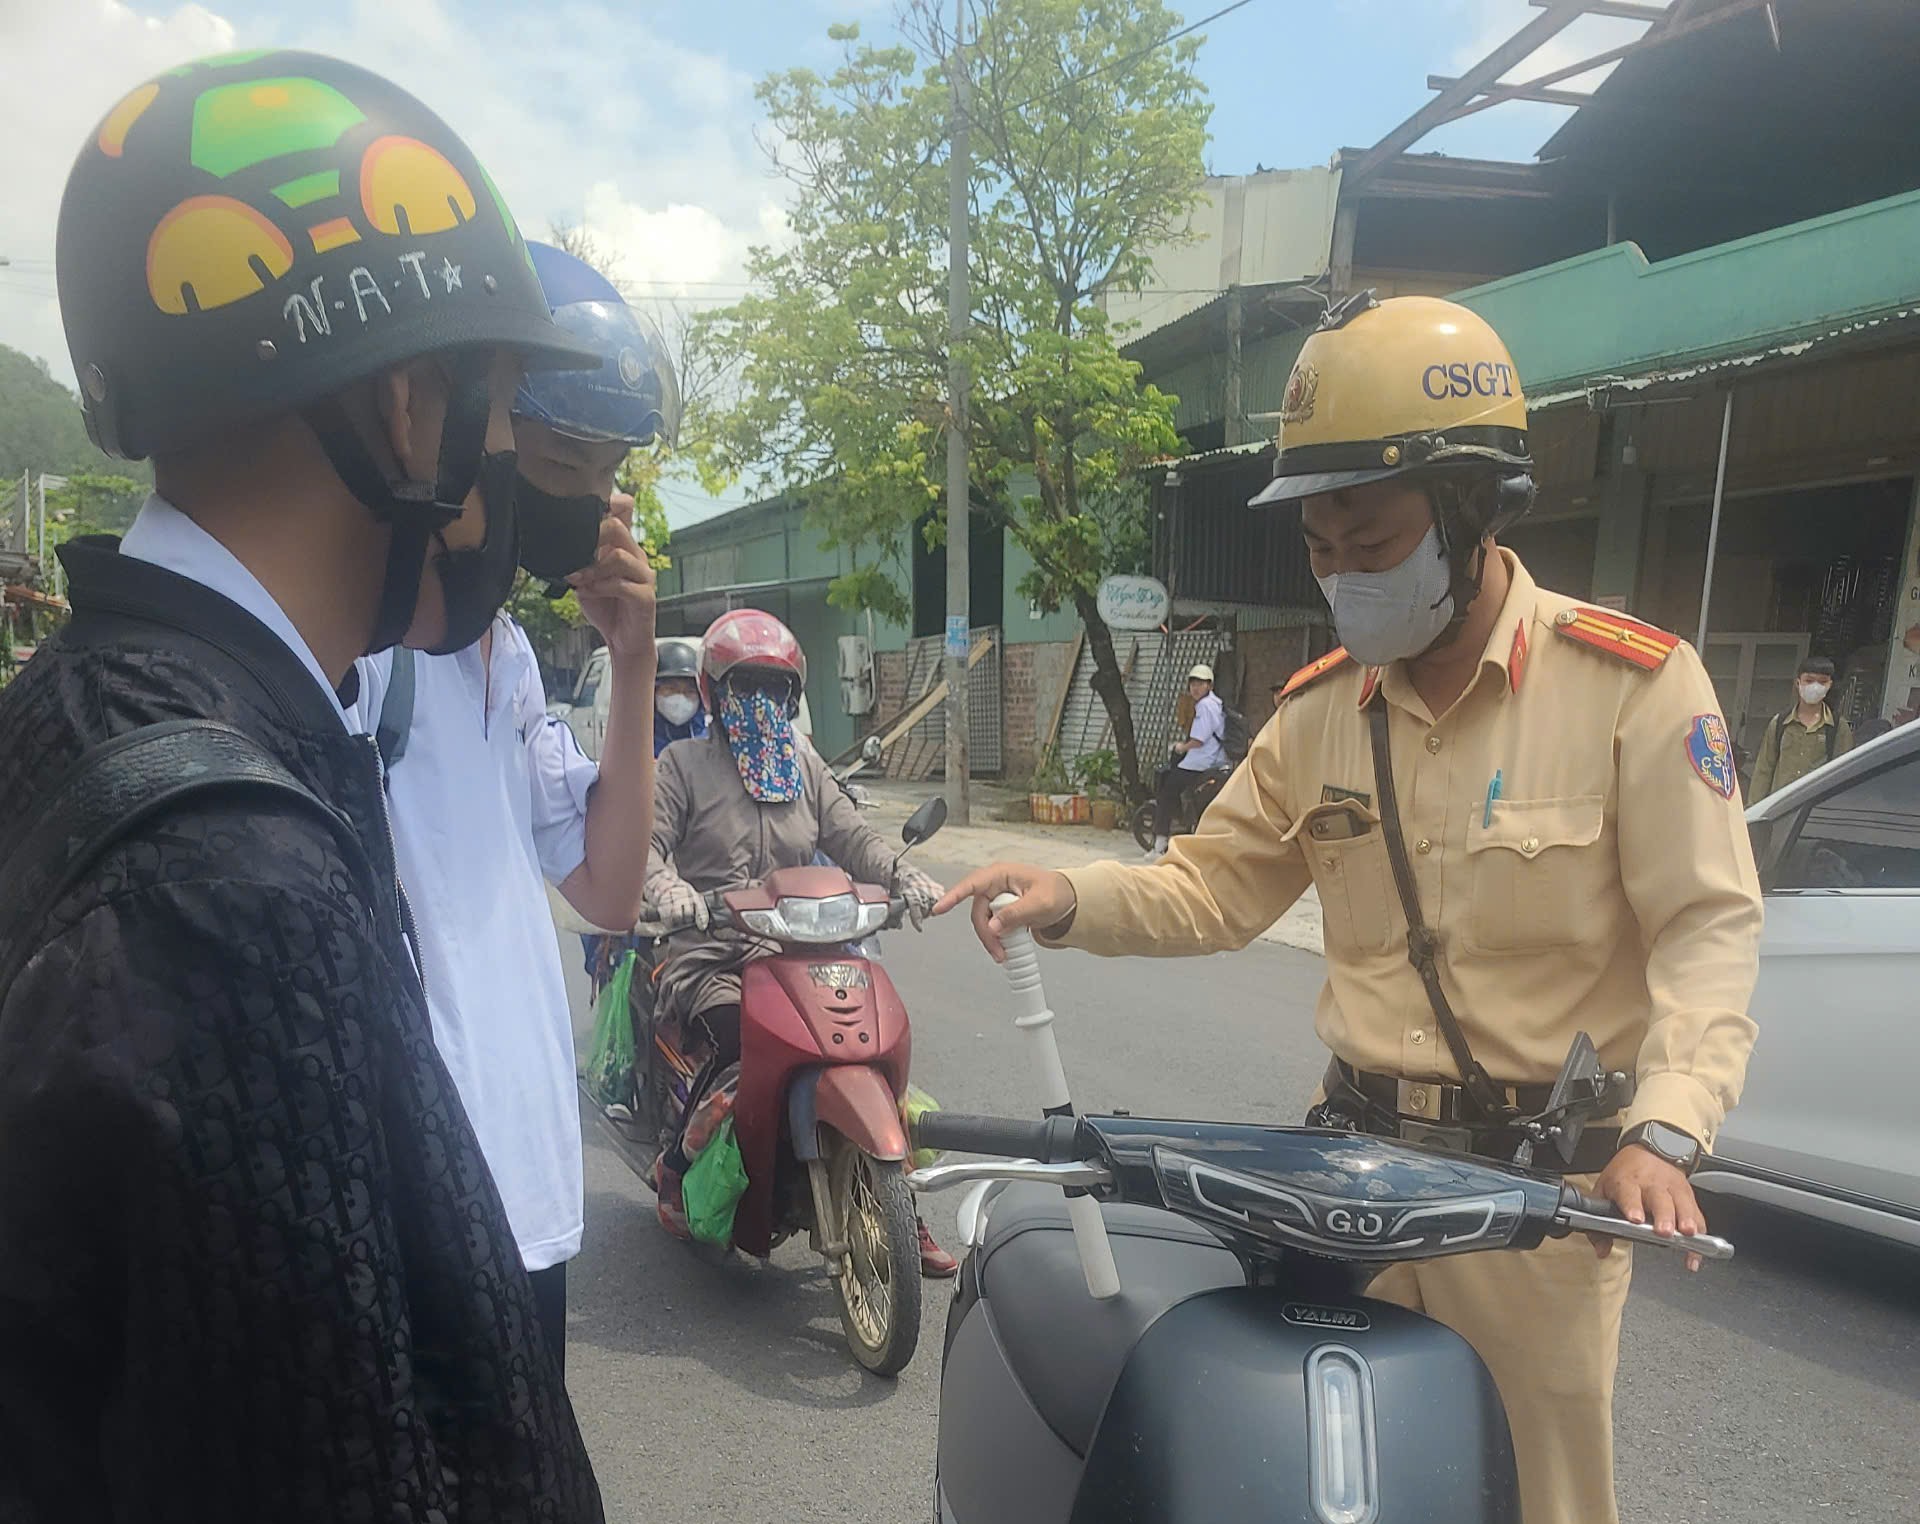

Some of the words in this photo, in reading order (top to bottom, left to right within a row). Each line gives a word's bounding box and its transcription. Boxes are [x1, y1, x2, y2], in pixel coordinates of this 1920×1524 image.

[1422, 361, 1512, 400] CSGT
[1326, 1209, 1383, 1237] GO
[1294, 1307, 1357, 1326] YALIM
